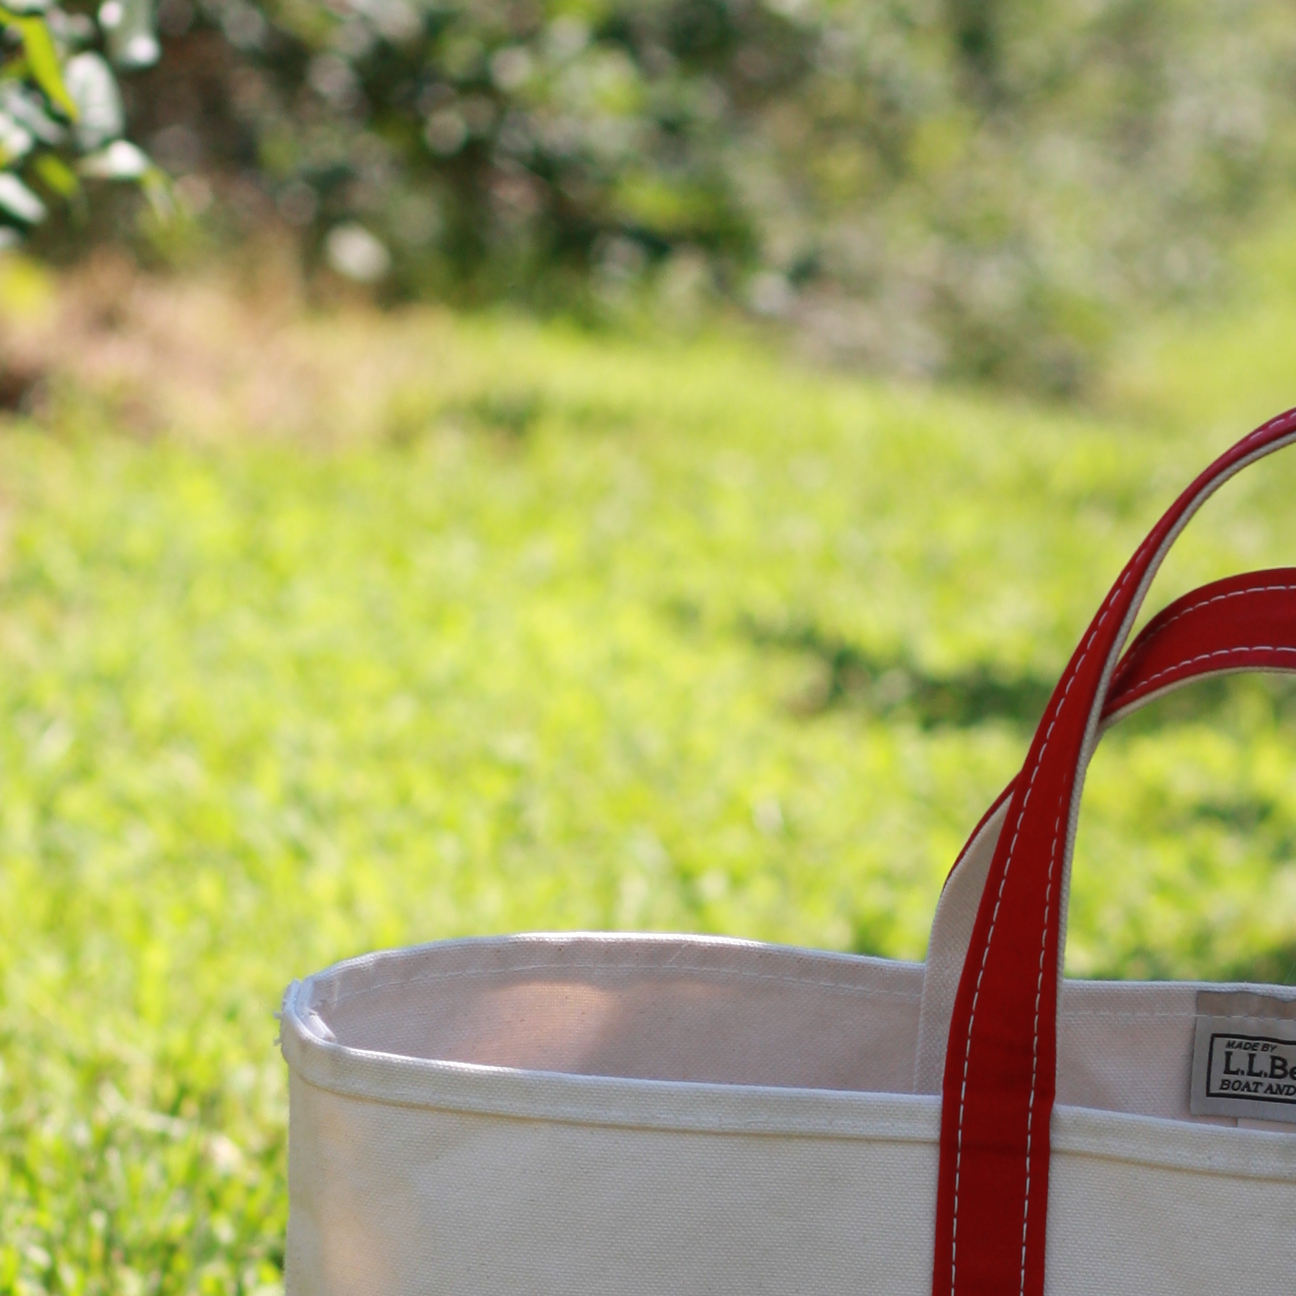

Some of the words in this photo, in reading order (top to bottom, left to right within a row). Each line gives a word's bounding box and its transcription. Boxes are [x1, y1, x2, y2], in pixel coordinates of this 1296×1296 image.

[1225, 1040, 1258, 1051] MADE
[1261, 1043, 1277, 1053] BY
[1219, 1079, 1263, 1093] BOAT
[1263, 1083, 1296, 1096] AND
